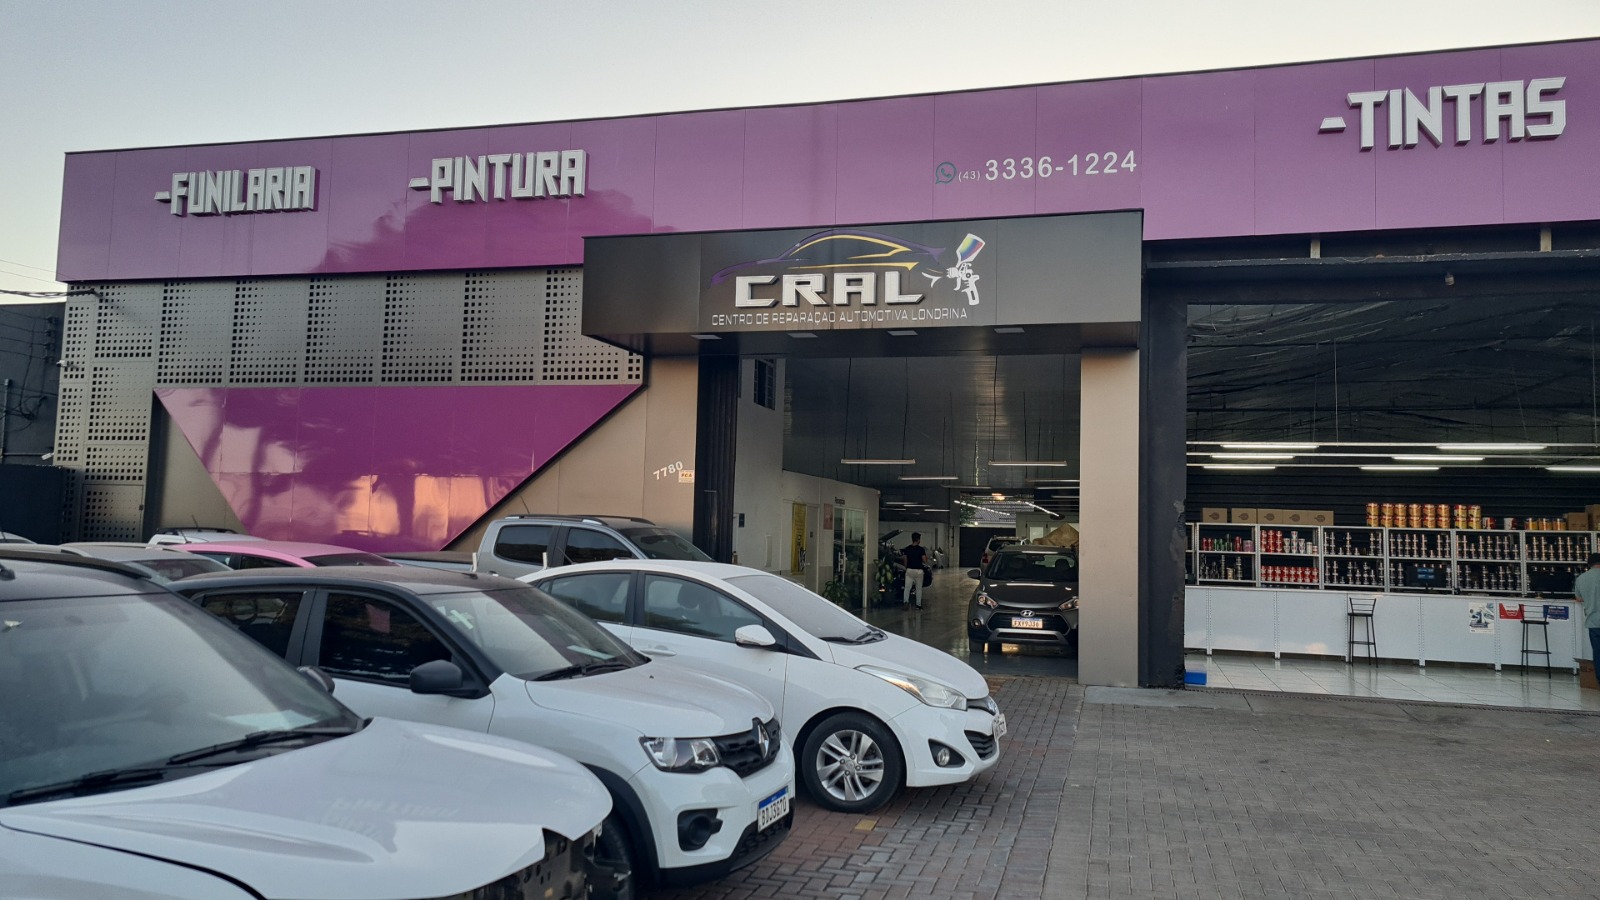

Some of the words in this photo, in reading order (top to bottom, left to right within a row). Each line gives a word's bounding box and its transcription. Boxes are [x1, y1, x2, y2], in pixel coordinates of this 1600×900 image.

[958, 170, 981, 182] (43)
[985, 150, 1137, 181] 3336-1224
[735, 270, 924, 308] CRAL
[711, 313, 753, 326] CENTRO
[755, 313, 769, 325] DE
[839, 309, 909, 322] AUTOMOTIVA
[911, 307, 968, 321] LONDRINA
[652, 460, 684, 480] 7780
